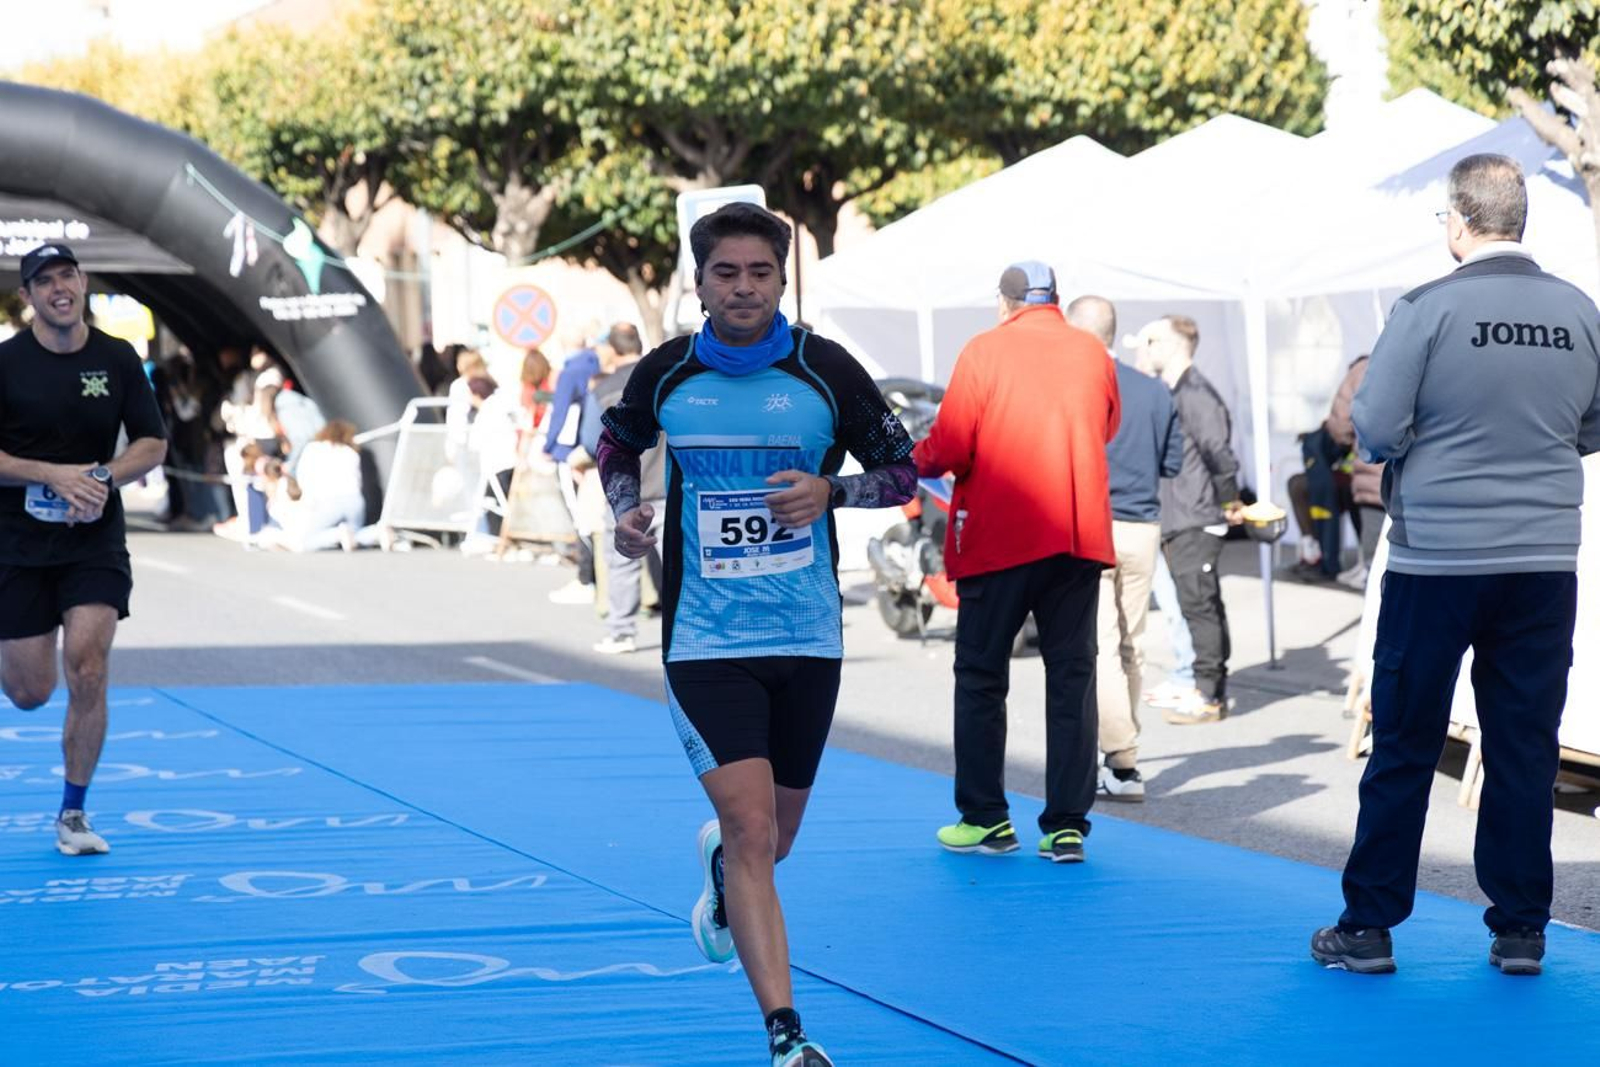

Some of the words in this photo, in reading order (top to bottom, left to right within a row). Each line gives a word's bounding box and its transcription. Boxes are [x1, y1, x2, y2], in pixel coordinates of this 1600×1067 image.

[767, 434, 802, 446] BAENA
[721, 515, 794, 545] 592
[74, 977, 314, 997] MEDIA
